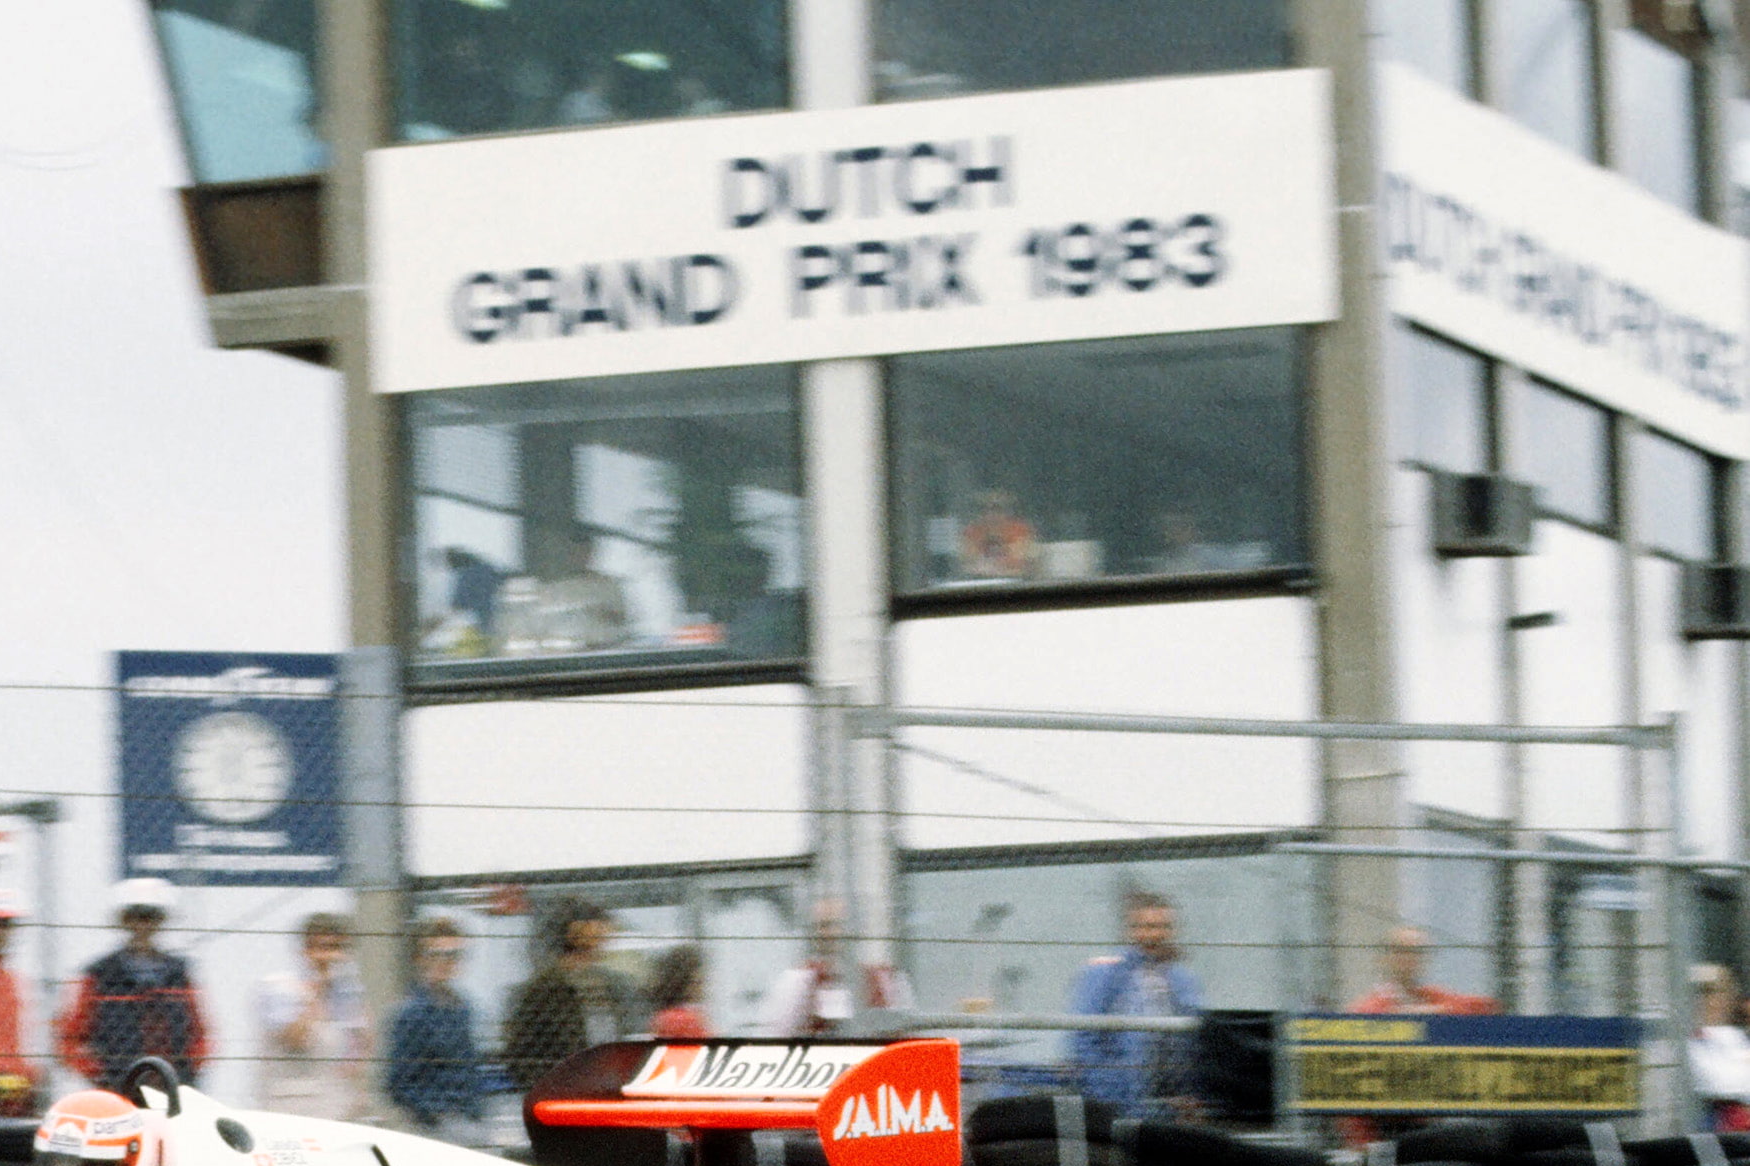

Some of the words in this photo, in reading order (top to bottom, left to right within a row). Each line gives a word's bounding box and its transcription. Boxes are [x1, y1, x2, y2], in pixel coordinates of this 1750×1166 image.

[720, 134, 1014, 229] DUTCH
[447, 253, 741, 343] GRAND
[788, 232, 983, 319] PRIX
[1014, 213, 1228, 300] 1983
[690, 1045, 854, 1089] Marlbo
